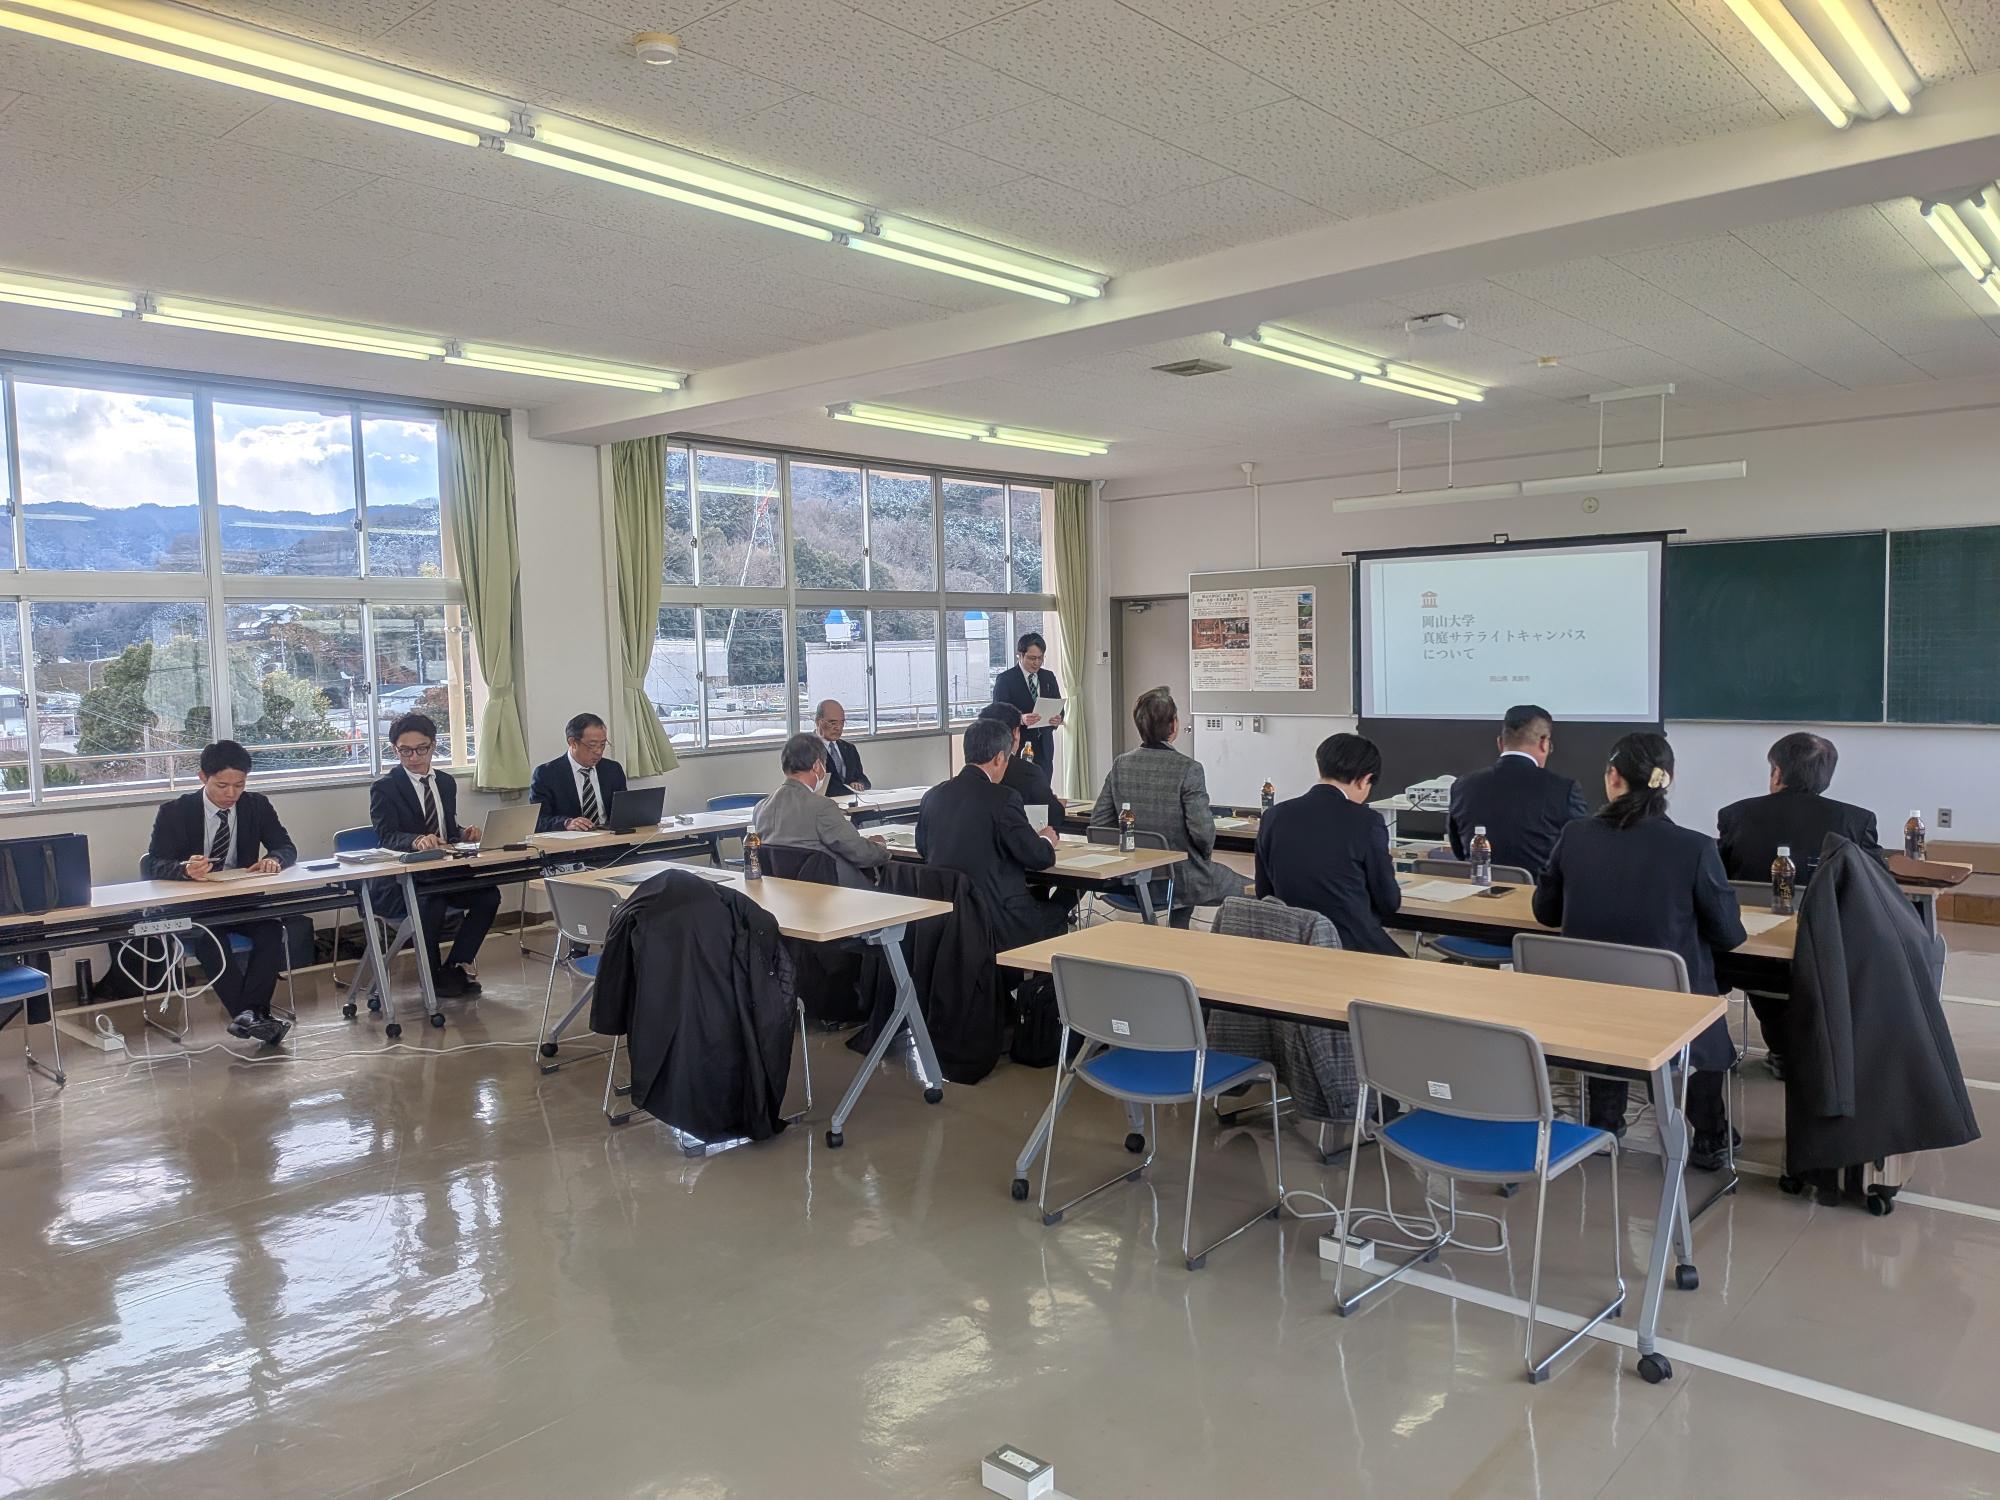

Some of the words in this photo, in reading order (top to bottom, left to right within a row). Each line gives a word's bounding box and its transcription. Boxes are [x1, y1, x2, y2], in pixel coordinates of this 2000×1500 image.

[1422, 614, 1475, 629] 岡山大学
[1423, 629, 1587, 645] 真庭サテライトキャンパス
[1423, 648, 1475, 660] について
